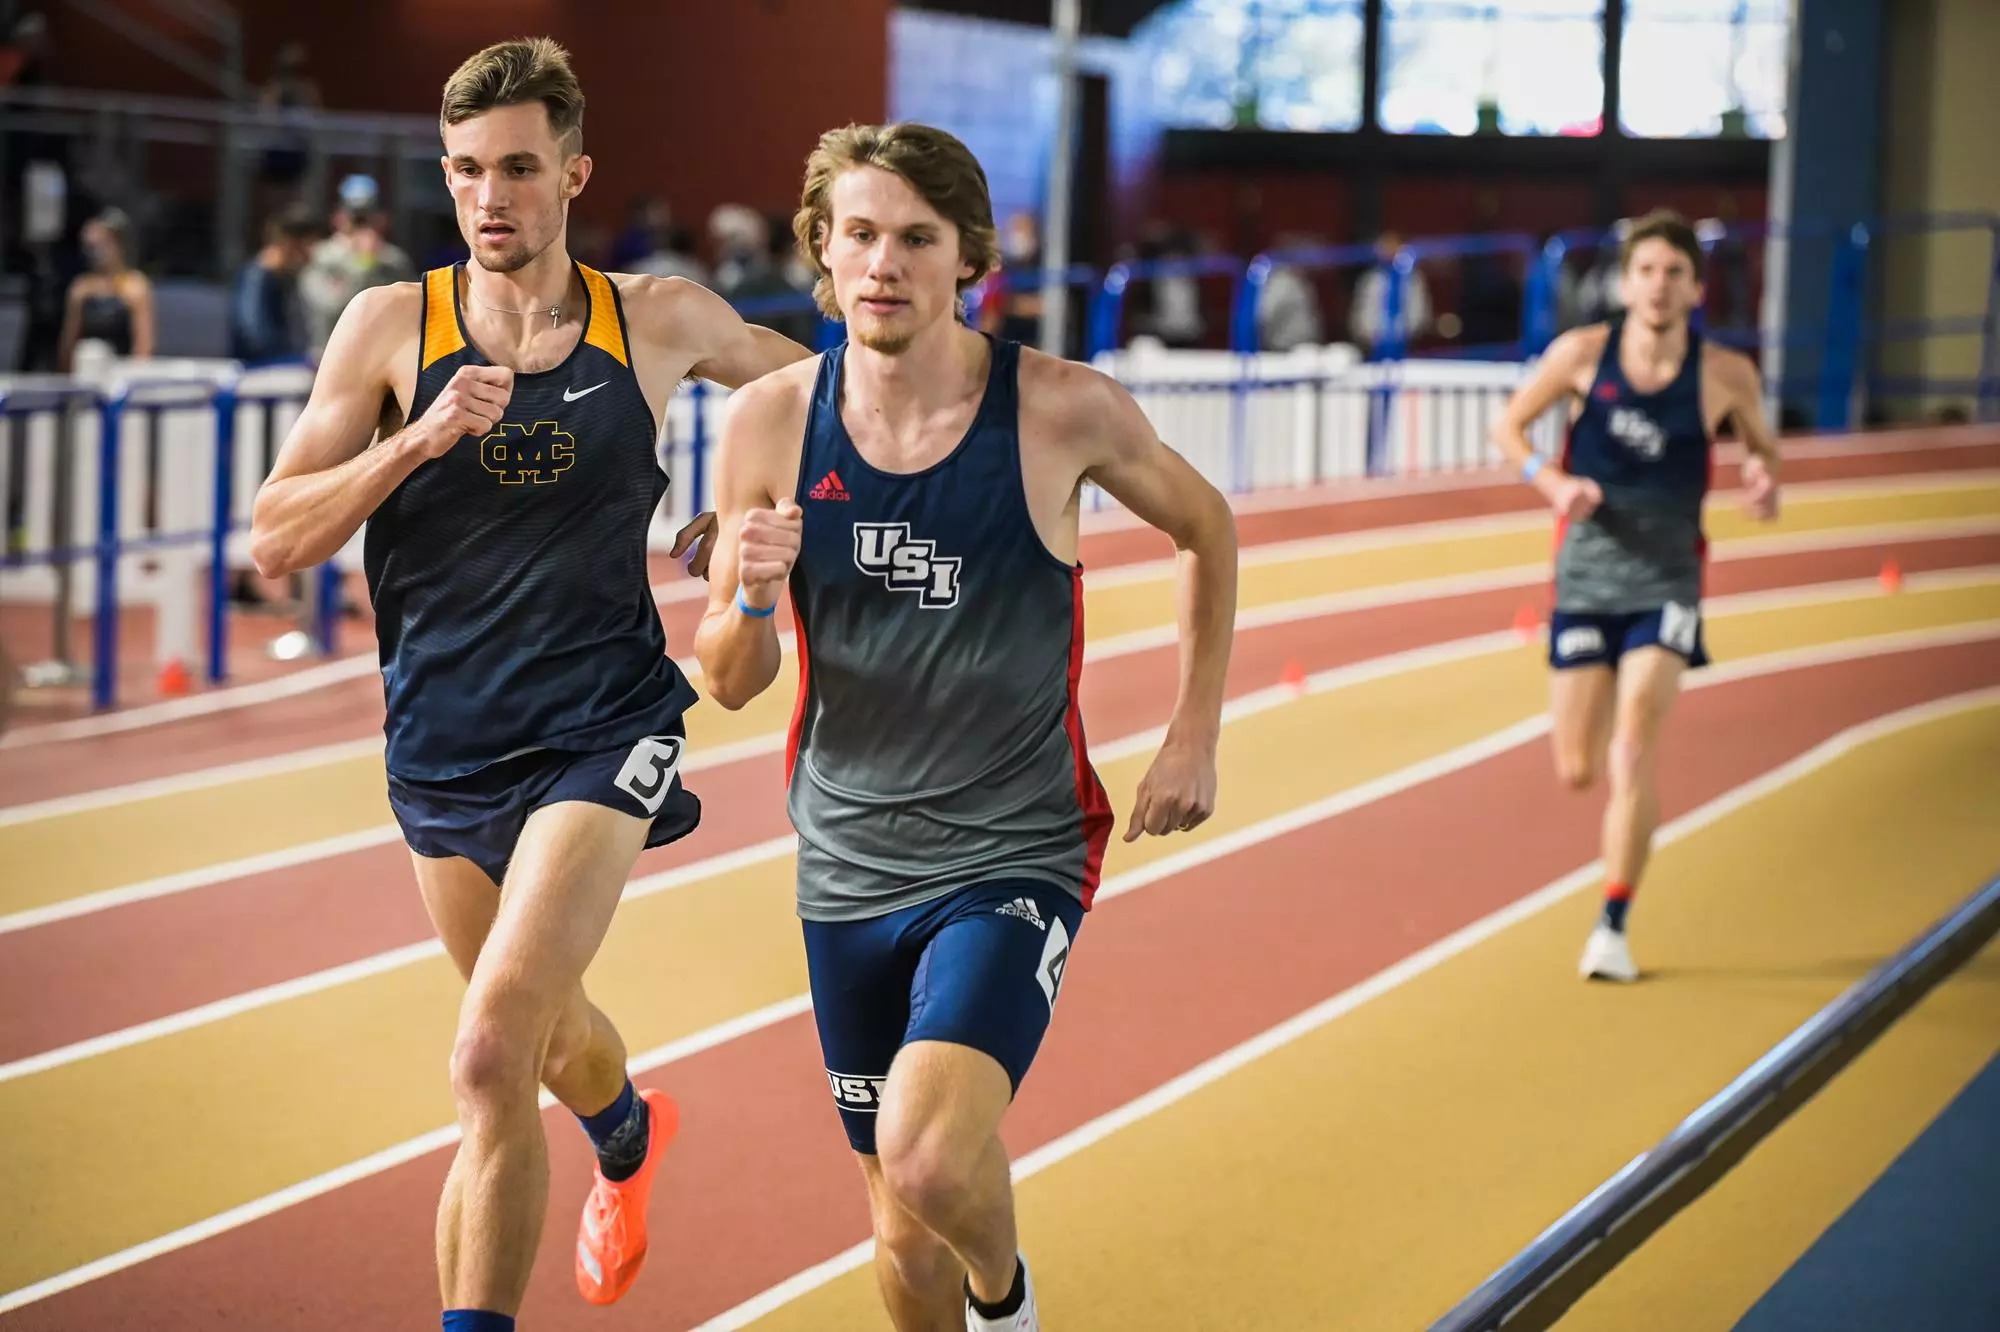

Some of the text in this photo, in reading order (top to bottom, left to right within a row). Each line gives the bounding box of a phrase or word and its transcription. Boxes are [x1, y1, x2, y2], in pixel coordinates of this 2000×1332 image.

[809, 489, 850, 501] adidas
[855, 523, 961, 608] USI
[629, 739, 680, 799] 3
[995, 907, 1046, 931] adidas
